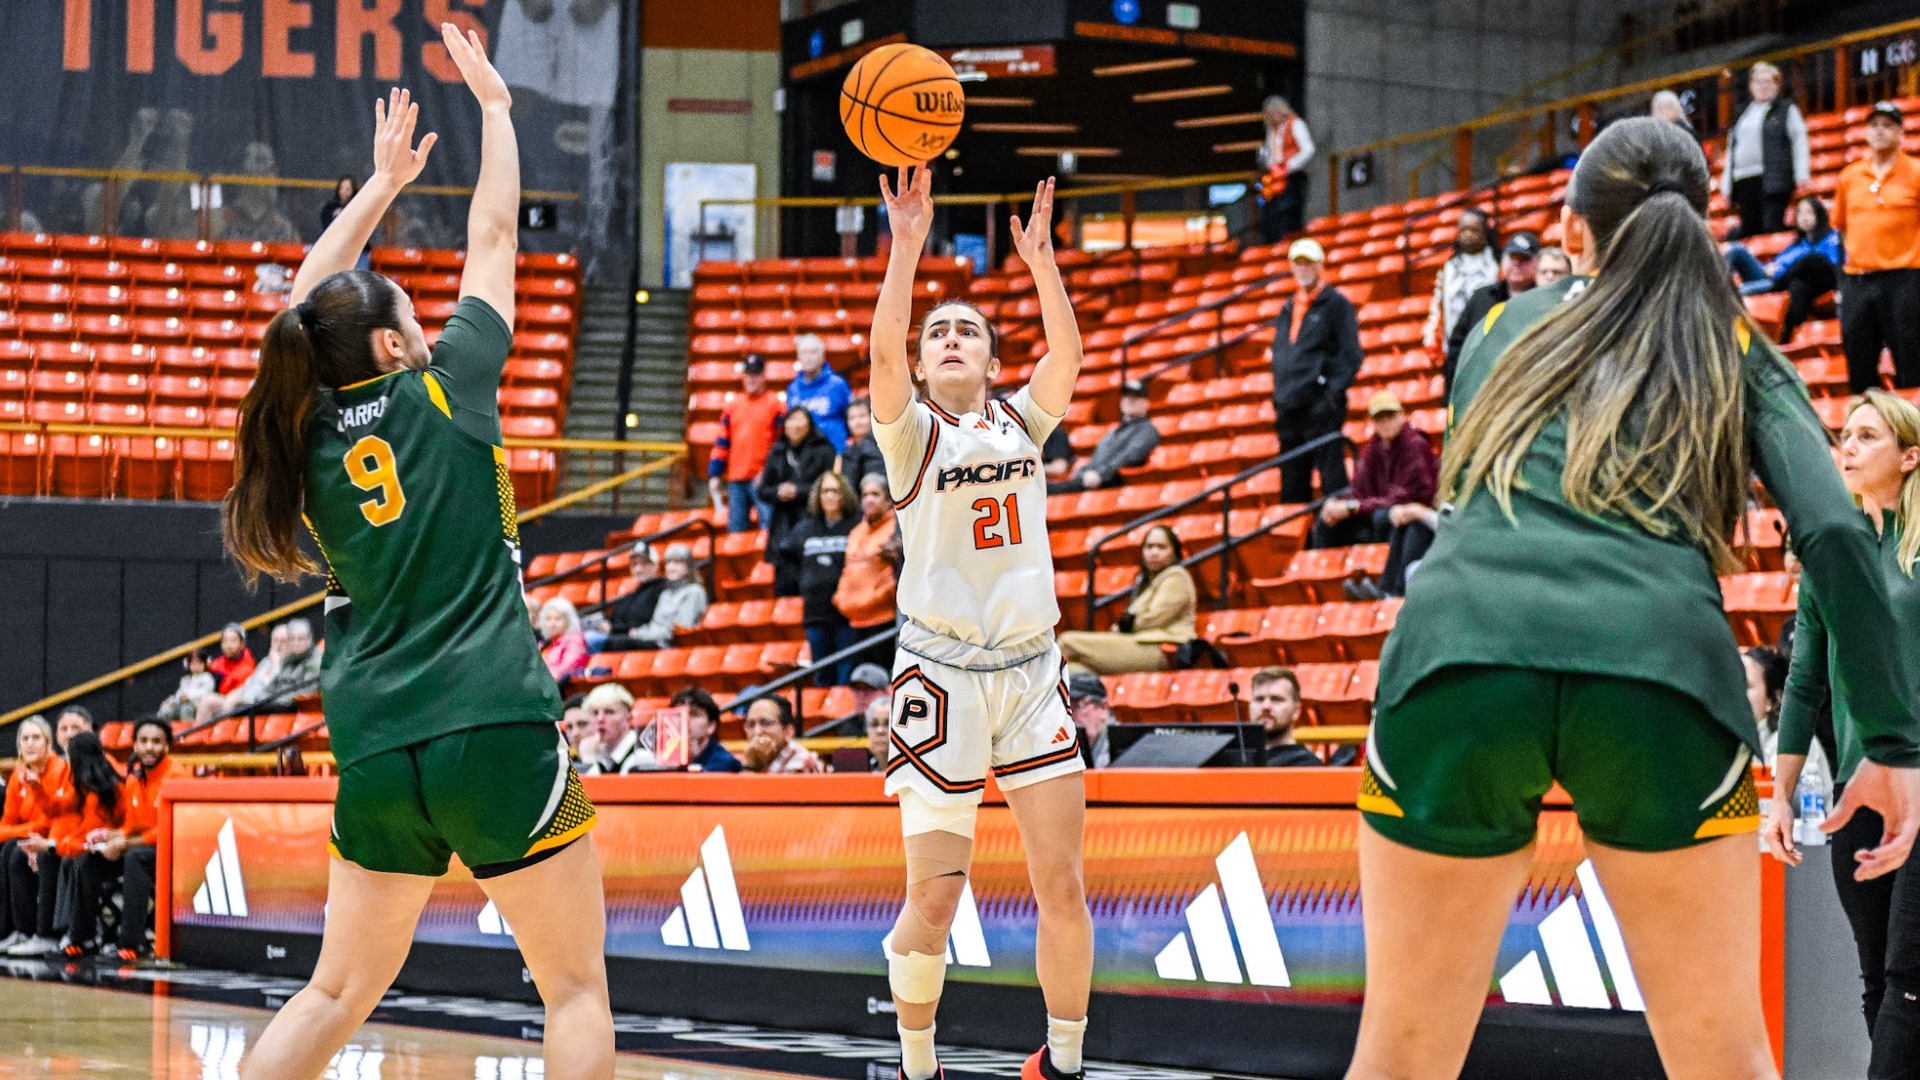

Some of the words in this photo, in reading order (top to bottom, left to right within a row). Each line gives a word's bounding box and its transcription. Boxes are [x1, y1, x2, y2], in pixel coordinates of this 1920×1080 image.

[343, 434, 406, 527] 9
[971, 493, 1022, 550] 21
[896, 695, 930, 728] P
